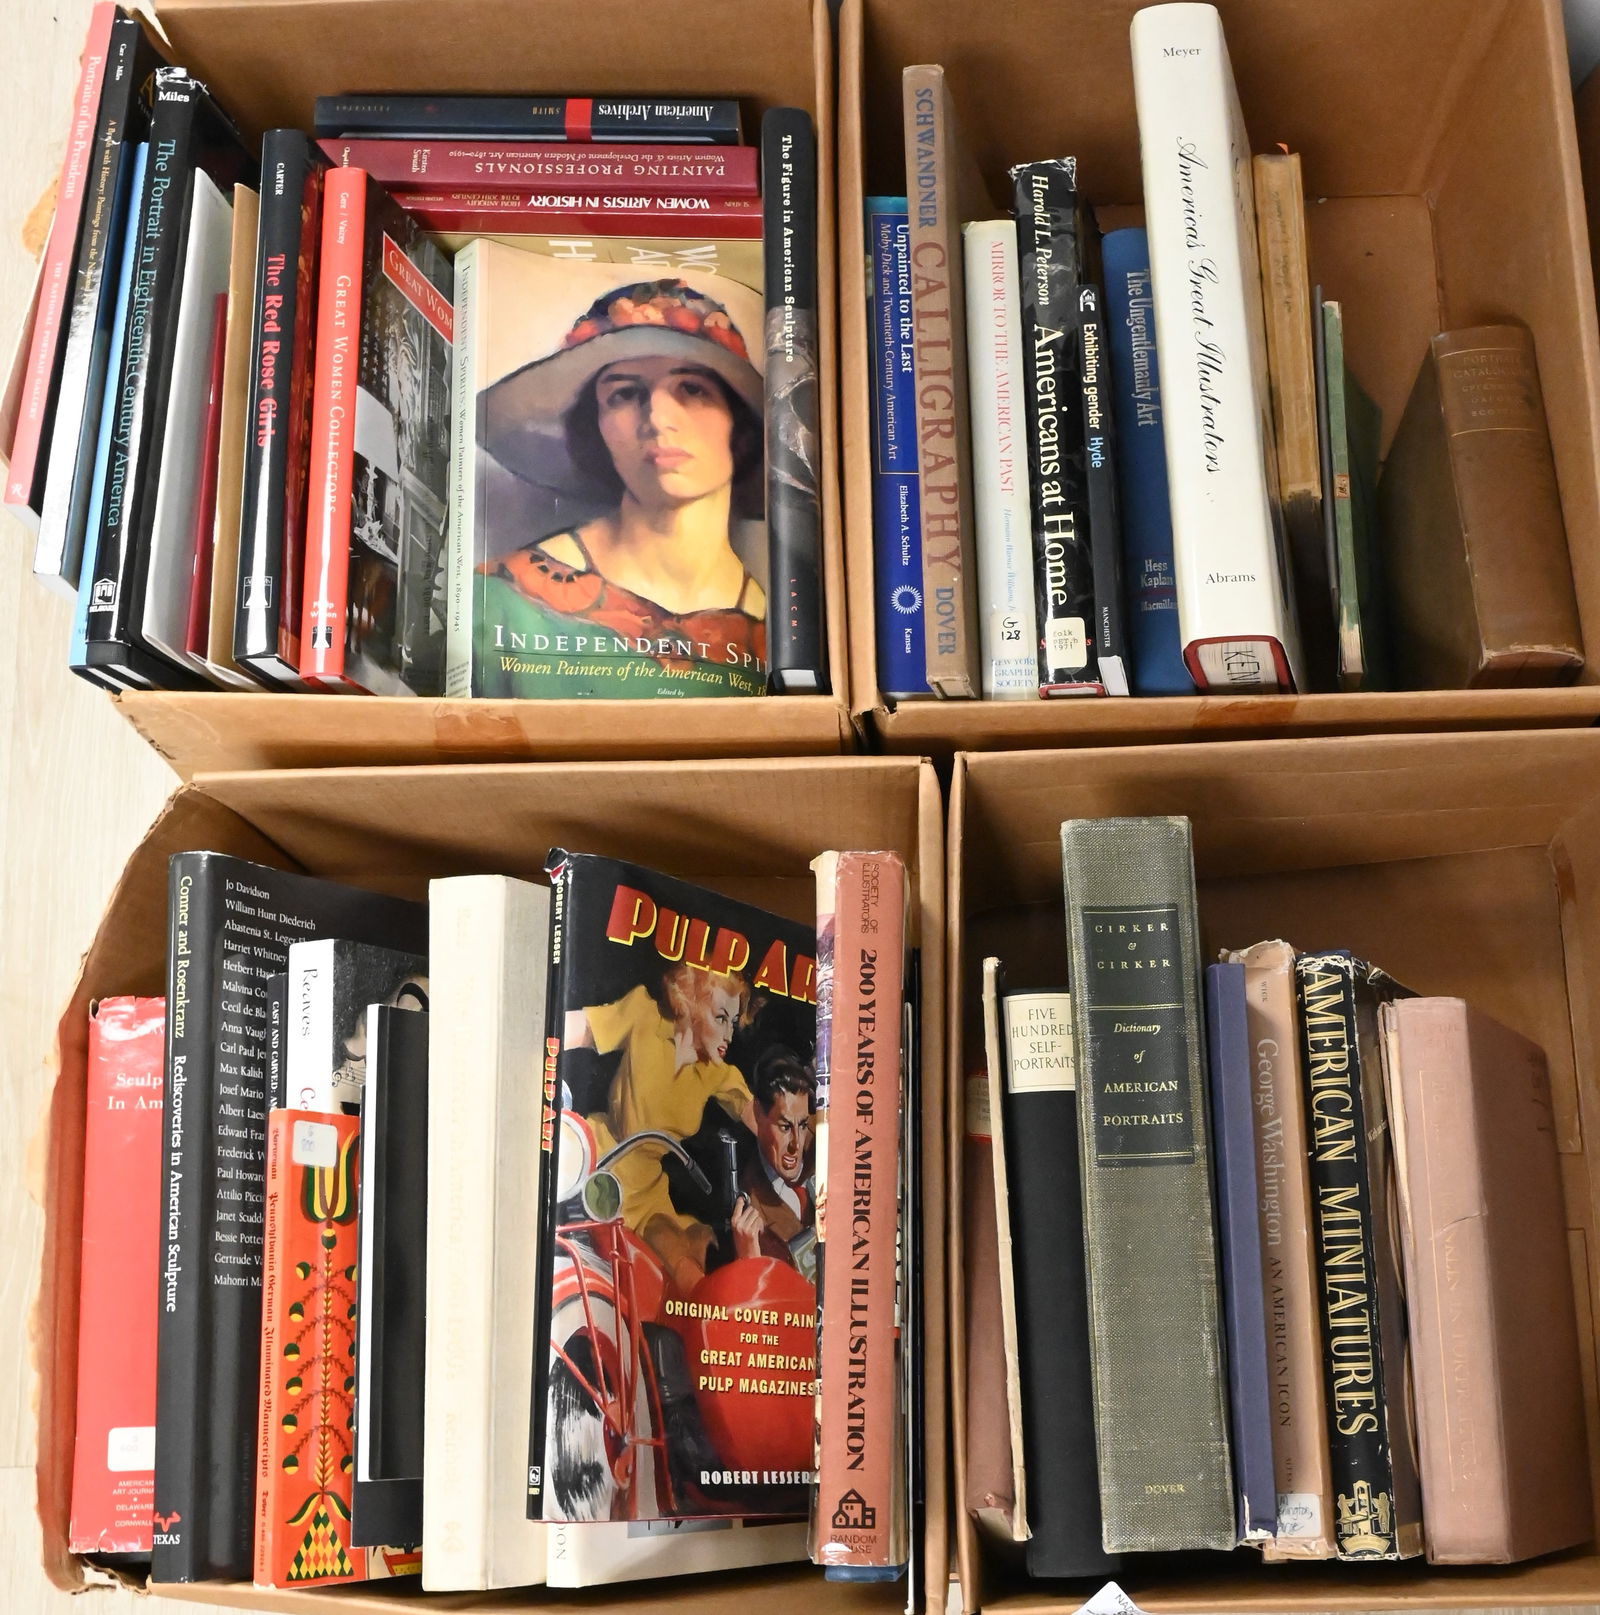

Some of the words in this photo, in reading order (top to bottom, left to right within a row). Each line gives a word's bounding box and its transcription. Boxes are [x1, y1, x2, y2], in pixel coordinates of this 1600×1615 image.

[1161, 47, 1202, 58] Meyer
[81, 56, 102, 105] Portraits
[159, 91, 189, 102] Miles
[532, 107, 561, 115] SMITH
[598, 104, 652, 121] Archives
[655, 104, 714, 122] American
[155, 139, 176, 171] The
[588, 152, 639, 162] Development
[782, 135, 792, 160] The
[914, 88, 937, 229] SCHWANDNER
[275, 163, 286, 196] CARTER
[475, 162, 622, 175] PROFESSIONALS
[633, 164, 725, 176] PAINTING
[780, 164, 793, 206] Figure
[1176, 137, 1208, 249] America's
[93, 196, 106, 228] Paintings
[145, 177, 170, 239] Portrait
[526, 195, 583, 207] HISTORY
[603, 196, 653, 208] ARTISTS
[657, 198, 711, 209] WOMEN
[1031, 174, 1051, 225] Harold
[336, 219, 348, 245] Vaizey
[266, 254, 285, 287] The
[783, 227, 794, 292] American
[893, 223, 912, 295] Unpainted
[389, 250, 422, 296] GREAT
[1035, 247, 1053, 306] Peterson
[44, 282, 60, 326] NATIONAL
[333, 274, 352, 328] GREAT
[1188, 258, 1220, 329] Great
[264, 295, 284, 333] Red
[459, 265, 471, 352] INDEPENDENT
[783, 295, 795, 363] Sculpture
[881, 297, 896, 390] Twentieth-Century
[1083, 323, 1099, 384] Exhibiting
[1126, 297, 1158, 401] Ungentlemanly
[114, 270, 156, 447] Eighteenth-Century
[259, 340, 281, 389] Rose
[330, 336, 348, 400] WOMEN
[900, 343, 914, 373] Last
[911, 241, 961, 573] CALLIGRAPHY
[995, 370, 1013, 453] AMERICAN
[1033, 324, 1068, 476] Americans
[1083, 386, 1102, 429] gender
[1194, 330, 1227, 474] Illustrators
[1087, 436, 1106, 468] Hyde
[106, 451, 130, 527] America
[1040, 480, 1066, 507] at
[899, 485, 909, 522] Elizabeth
[1043, 511, 1075, 606] Home
[1144, 559, 1168, 573] Hess
[1141, 573, 1174, 589] Kaplan
[1205, 572, 1256, 584] Abrams
[935, 587, 956, 656] DOVER
[1003, 617, 1018, 629] G
[1101, 606, 1111, 648] MANCHESTER
[494, 624, 711, 659] INDEPENDENT
[904, 627, 913, 654] Kansas
[1001, 630, 1021, 641] 128
[500, 656, 551, 674] Women
[557, 661, 612, 677] Painters
[635, 661, 656, 677] the
[658, 663, 723, 684] American
[657, 687, 678, 696] Edited
[996, 679, 1034, 688] SOCIETY
[236, 882, 270, 900] Davidson
[861, 863, 871, 934] ILLUSTRATORS
[870, 864, 880, 907] SOCIETY
[225, 899, 256, 916] William
[279, 913, 316, 930] Diederich
[1095, 922, 1170, 933] CIRKER
[224, 920, 261, 938] Abastenia
[606, 884, 750, 978] PULP
[177, 930, 191, 955] and
[224, 939, 251, 955] Harriet
[253, 945, 288, 966] Whitney
[552, 924, 562, 965] LESSER
[1127, 941, 1137, 951] &
[223, 960, 253, 976] Herbert
[858, 949, 877, 996] 200
[1097, 959, 1171, 969] CIRKER
[175, 959, 190, 1038] Rosenkranz
[222, 980, 252, 997] Malvina
[1260, 980, 1268, 1003] WICK
[221, 1001, 241, 1014] Cecil
[272, 1001, 280, 1026] CAST
[302, 968, 318, 1037] Reaves
[1028, 1007, 1057, 1021] FIVE
[221, 1021, 243, 1034] Anna
[1012, 1024, 1074, 1038] HUNDRED
[1113, 1022, 1161, 1035] Dictionary
[220, 1042, 236, 1055] Carl
[856, 999, 876, 1085] YEARS
[1029, 1041, 1062, 1054] SELF-
[543, 1036, 560, 1101] PULP
[1013, 1057, 1075, 1071] PORTRAITS
[1133, 1050, 1146, 1063] of
[1303, 968, 1357, 1163] AMERICAN
[240, 1064, 264, 1079] Kalish
[1254, 1038, 1280, 1116] George
[219, 1083, 238, 1096] Josef
[1104, 1080, 1179, 1094] AMERICAN
[107, 1095, 125, 1110] In
[172, 1055, 187, 1148] Rediscoveries
[218, 1105, 245, 1118] Albert
[856, 1090, 874, 1126] OF
[218, 1126, 248, 1139] Edward
[1103, 1113, 1184, 1127] PORTRAITS
[217, 1146, 254, 1160] Frederick
[217, 1168, 233, 1180] Paul
[1260, 1117, 1286, 1247] Washington
[168, 1170, 183, 1240] American
[216, 1189, 243, 1202] Attilio
[852, 1129, 872, 1271] AMERICAN
[216, 1210, 237, 1223] Janet
[215, 1231, 238, 1243] Bessie
[214, 1253, 252, 1266] Gertrude
[164, 1244, 181, 1313] Sculpture
[214, 1274, 249, 1288] Mahonri
[665, 1300, 729, 1321] ORIGINAL
[734, 1308, 779, 1326] COVER
[1318, 1183, 1378, 1436] MINIATURES
[740, 1333, 758, 1344] FOR
[762, 1334, 779, 1346] THE
[1270, 1284, 1288, 1377] AMERICAN
[700, 1350, 742, 1367] GREAT
[748, 1355, 815, 1371] AMERICAN
[700, 1376, 734, 1392] PULP
[740, 1379, 816, 1396] MAGAZINES
[846, 1278, 869, 1472] ILLUSTRATION
[1278, 1383, 1291, 1427] ICON
[112, 1487, 126, 1495] ART
[118, 1480, 154, 1488] AMERICAN
[700, 1471, 758, 1485] ROBERT
[763, 1471, 811, 1485] LESSER
[1145, 1484, 1185, 1494] DOVER
[116, 1503, 154, 1512] DELAWARE
[115, 1520, 153, 1528] CORNWALL
[153, 1534, 181, 1545] TEXAS
[830, 1534, 877, 1544] RANDOM
